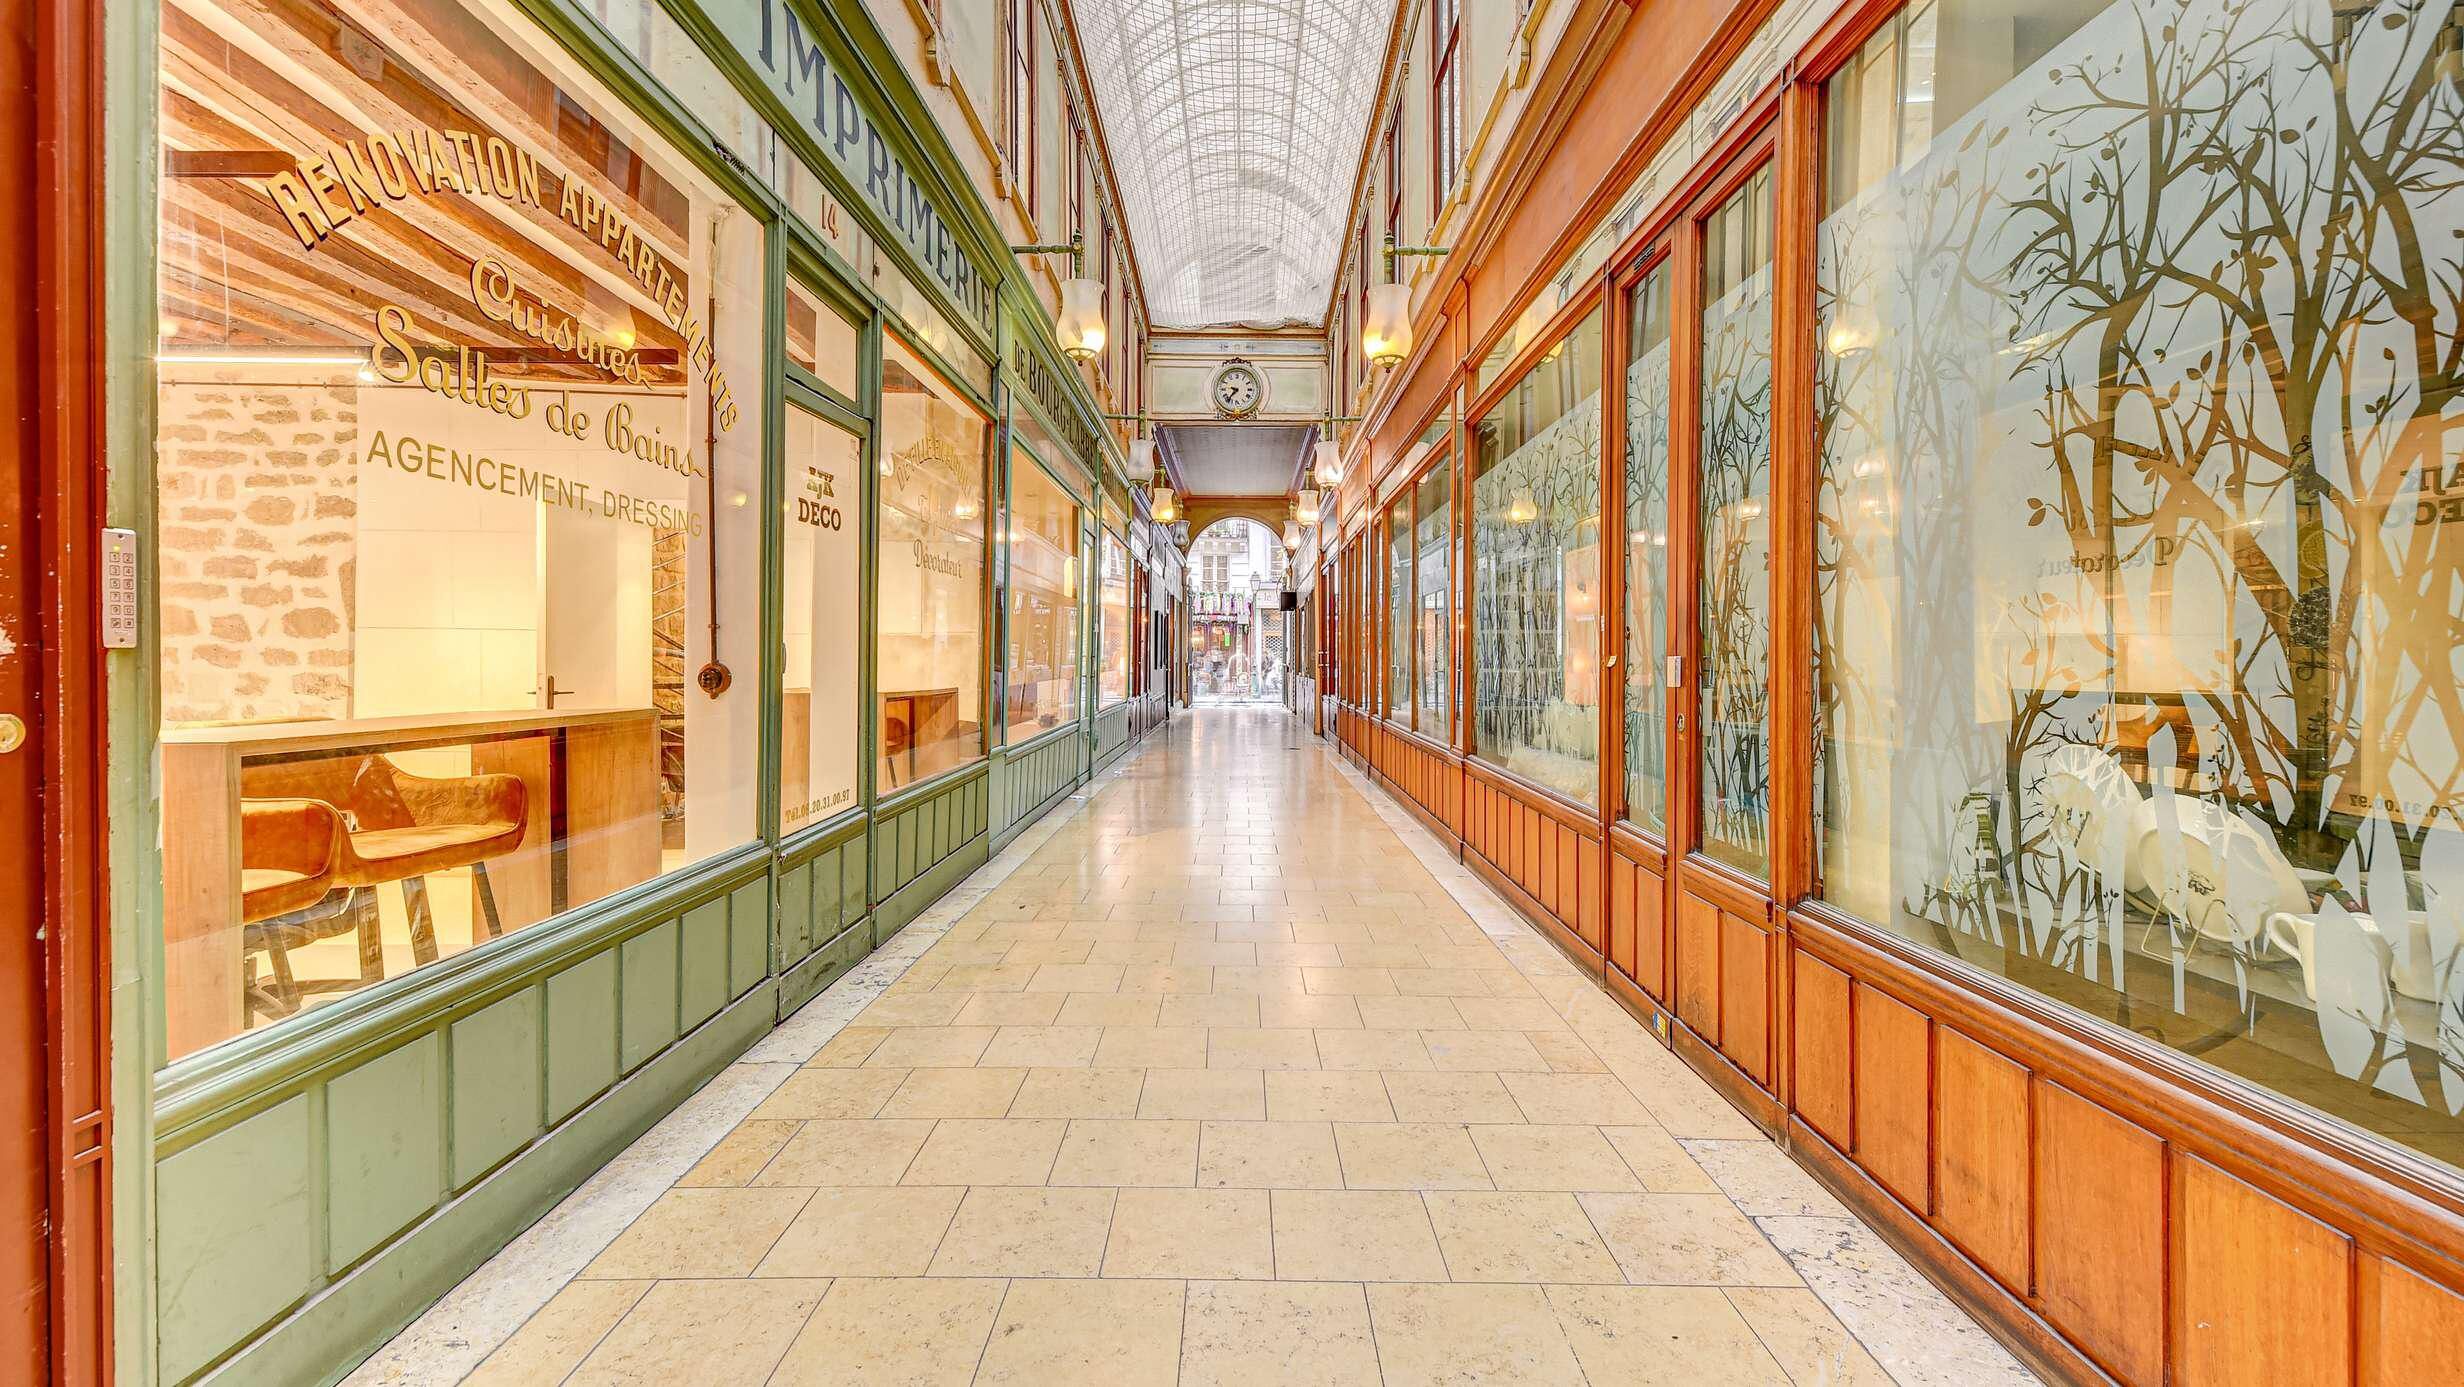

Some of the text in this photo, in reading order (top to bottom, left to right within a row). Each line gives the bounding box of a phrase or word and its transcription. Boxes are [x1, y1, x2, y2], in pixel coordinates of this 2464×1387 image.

[757, 0, 994, 341] IMPRIMERIE
[820, 194, 840, 241] 14
[266, 129, 739, 433] RENOVATION APPARTEMENTS
[470, 254, 658, 391] Cuisines
[371, 304, 708, 480] Salles de Bains
[1014, 340, 1026, 383] DE
[366, 430, 703, 538] AGENCEMENT, DRESSING
[798, 497, 842, 531] DECO
